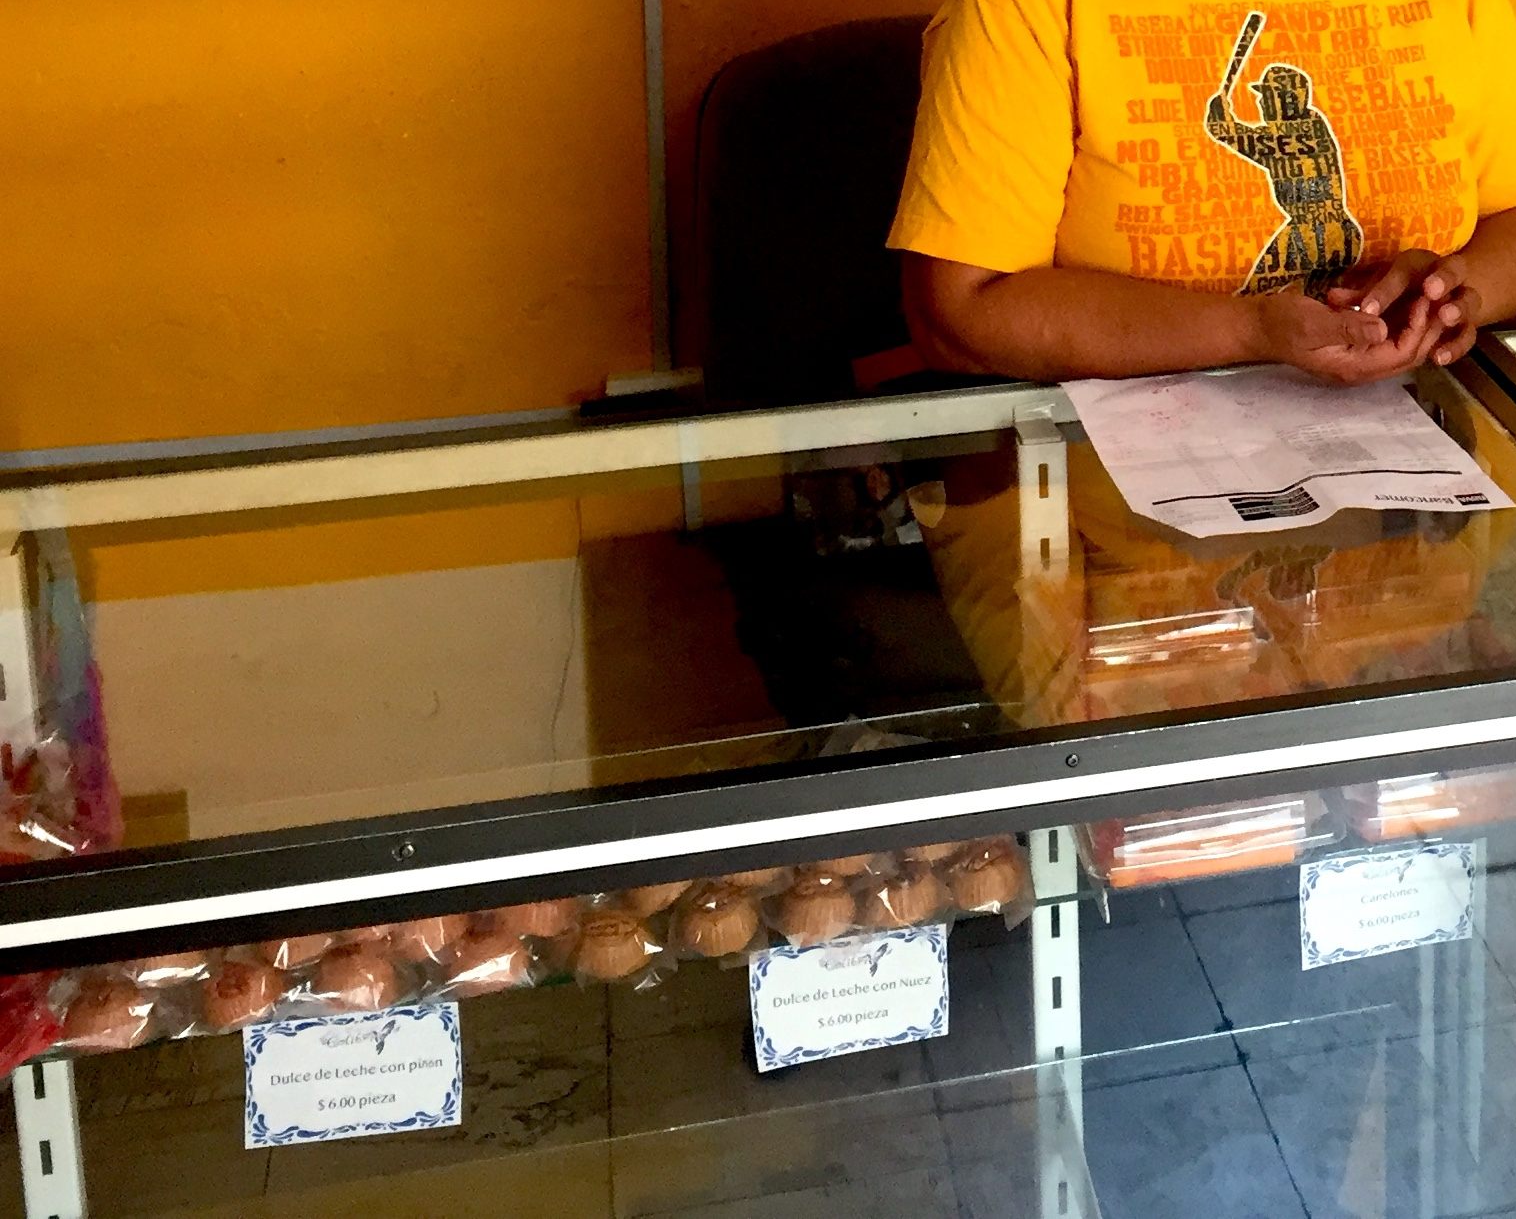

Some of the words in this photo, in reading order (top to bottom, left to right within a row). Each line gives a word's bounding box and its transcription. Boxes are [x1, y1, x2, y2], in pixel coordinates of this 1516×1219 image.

[1109, 13, 1213, 35] BASEBALL
[1126, 97, 1185, 125] SLIDE
[1116, 137, 1161, 164] NO
[1138, 160, 1198, 189] RBI
[1365, 140, 1438, 172] BASES
[1117, 202, 1165, 224] RBI
[1174, 199, 1253, 224] SLAM
[1360, 885, 1419, 905] Canelones
[772, 993, 811, 1008] Dulce
[813, 988, 830, 1001] de
[832, 984, 871, 998] Leche
[872, 980, 897, 993] con
[898, 975, 932, 989] Nuez
[854, 1009, 890, 1024] pieza
[270, 1070, 312, 1087] Dulce
[313, 1067, 333, 1081] de
[334, 1064, 377, 1080] Leche
[378, 1061, 406, 1075] con
[358, 1091, 397, 1108] pieza
